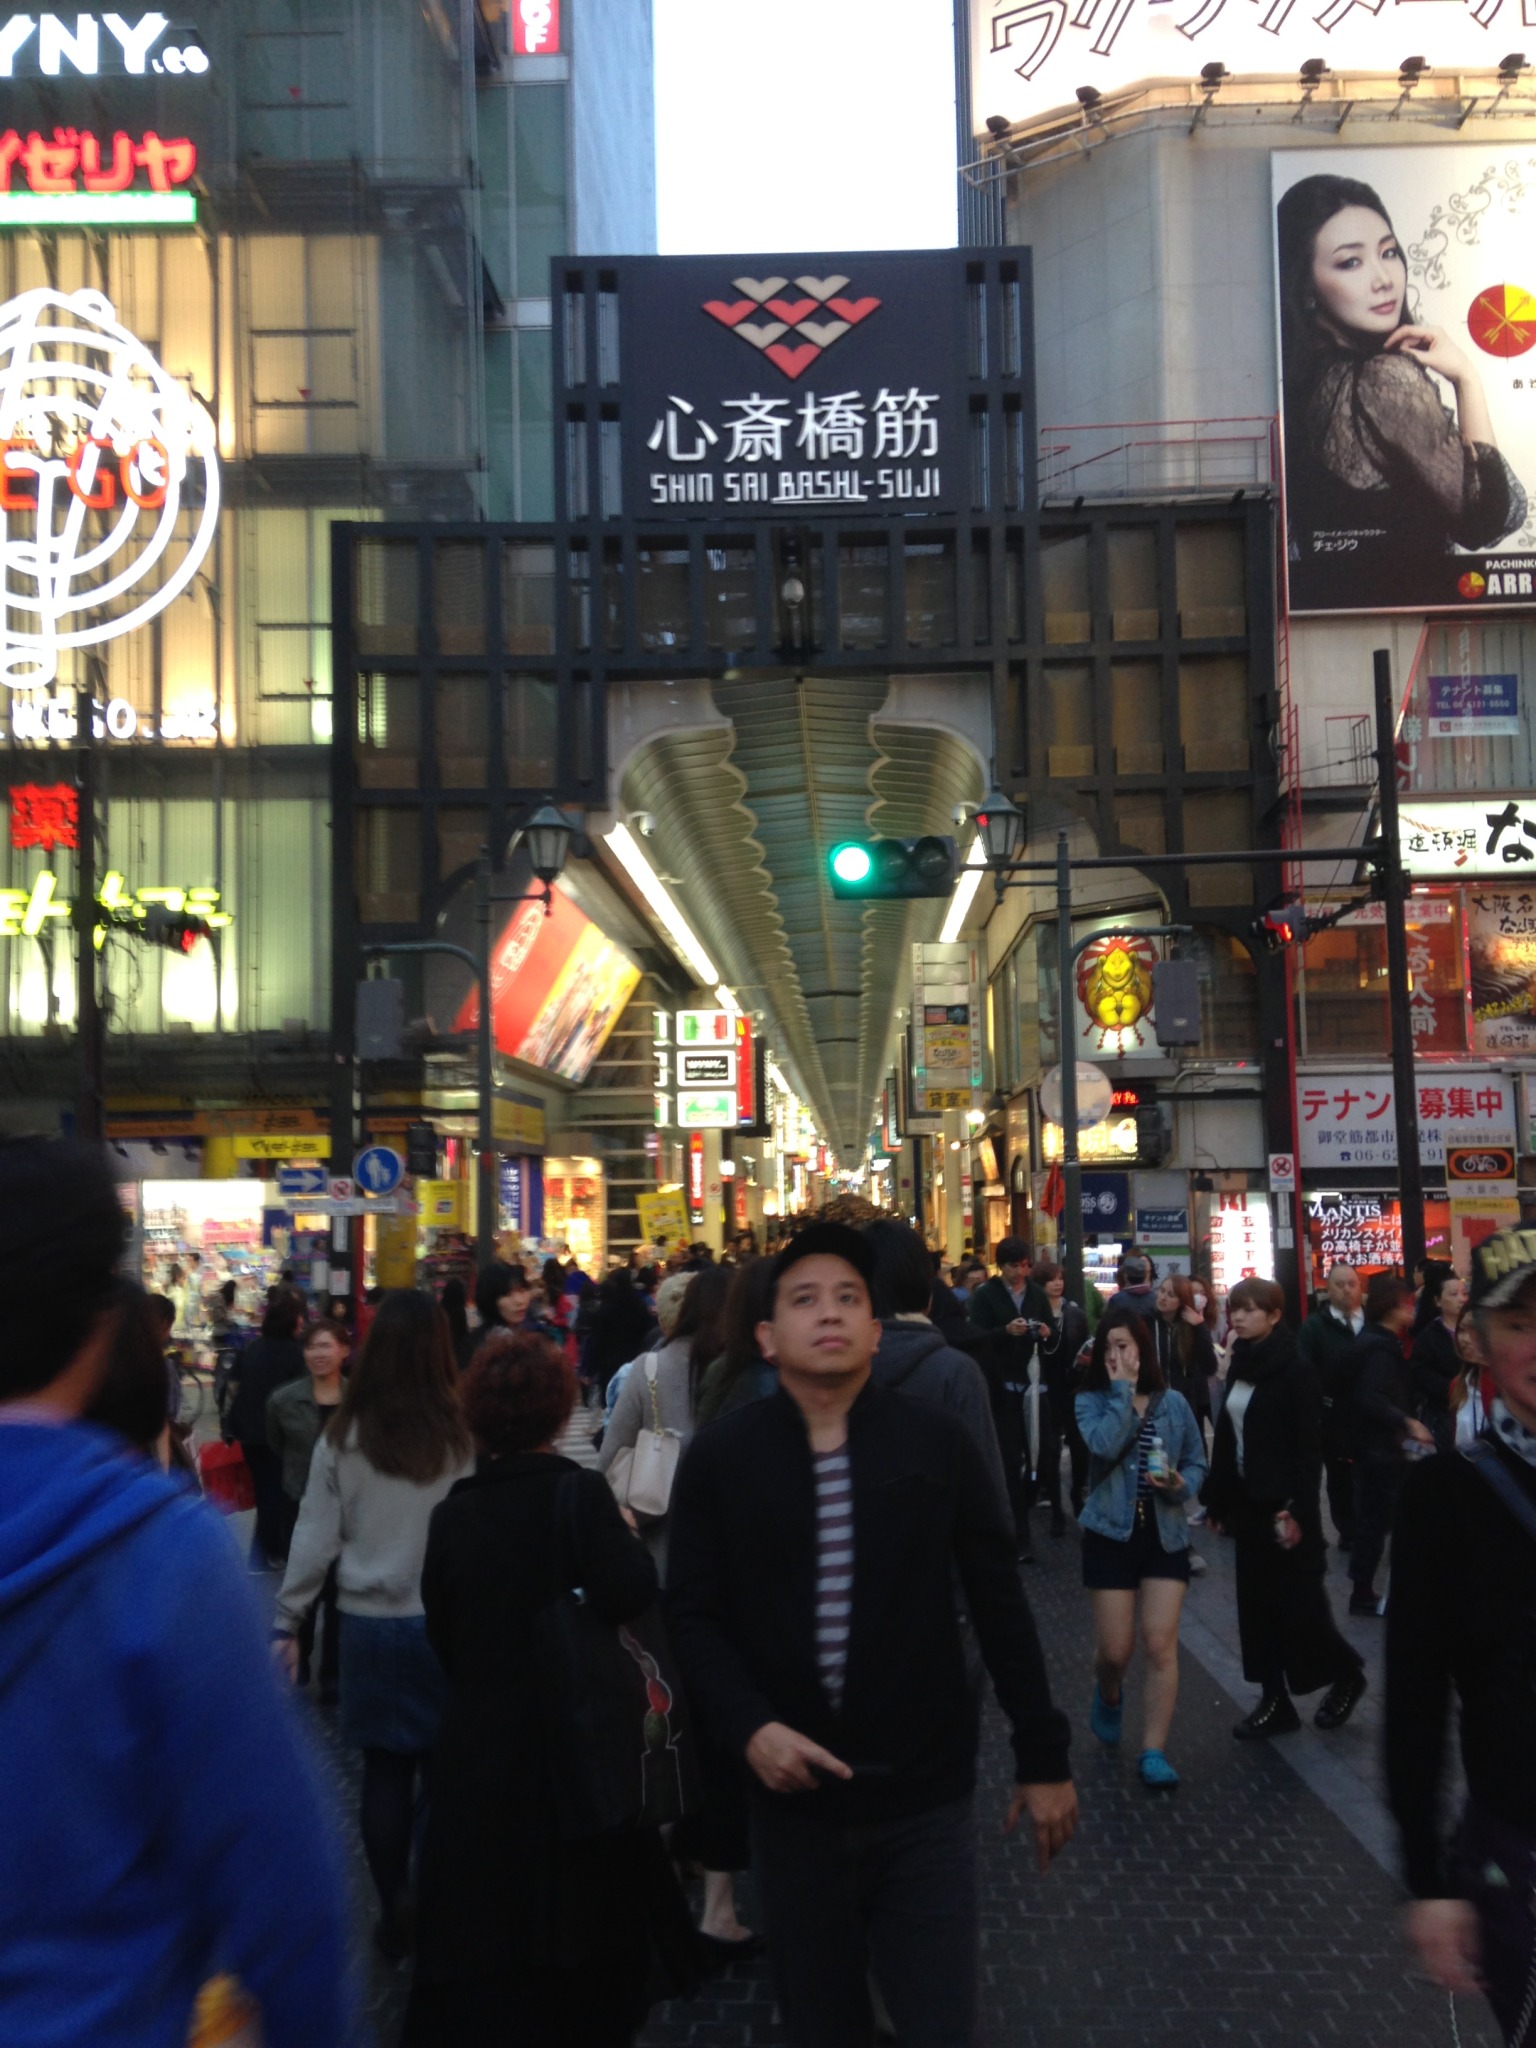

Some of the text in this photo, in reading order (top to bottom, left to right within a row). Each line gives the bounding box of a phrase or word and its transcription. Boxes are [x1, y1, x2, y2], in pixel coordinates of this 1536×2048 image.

[647, 387, 940, 463] 心斎橋筋
[649, 473, 714, 504] SHIN
[723, 471, 769, 502] SAI
[1485, 558, 1536, 570] PACHINK
[1407, 828, 1477, 853] 道頓堀
[1302, 1085, 1504, 1122] テナン募集中
